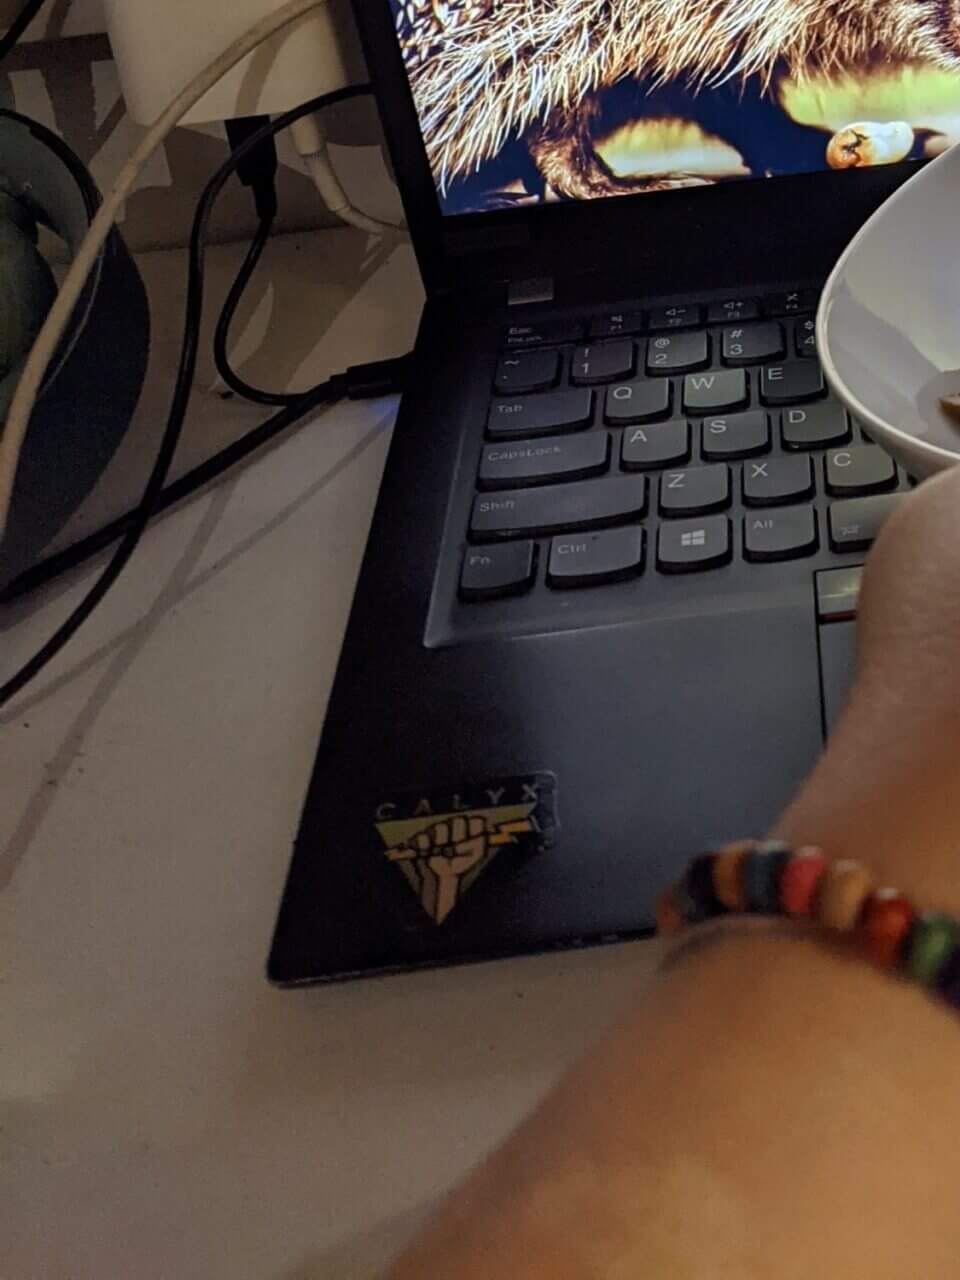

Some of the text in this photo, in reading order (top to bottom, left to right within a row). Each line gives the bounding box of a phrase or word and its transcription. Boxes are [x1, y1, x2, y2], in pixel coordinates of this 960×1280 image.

[729, 329, 743, 339] #
[654, 337, 670, 349] @
[804, 336, 816, 346] 4
[729, 344, 743, 355] 3
[655, 353, 668, 365] 2
[581, 363, 590, 374] 1
[767, 367, 784, 381] E
[691, 376, 715, 390] W
[613, 386, 633, 401] Q
[497, 403, 523, 414] Tab
[788, 409, 806, 424] D
[709, 419, 727, 434] S
[629, 429, 647, 443] A
[487, 445, 561, 462] CapsLock
[833, 453, 852, 467] C
[751, 463, 768, 478] X
[667, 473, 686, 489] Z
[479, 499, 516, 512] Shift
[753, 519, 773, 530] Alt
[556, 542, 587, 555] Ctrl
[469, 555, 491, 566] Fn
